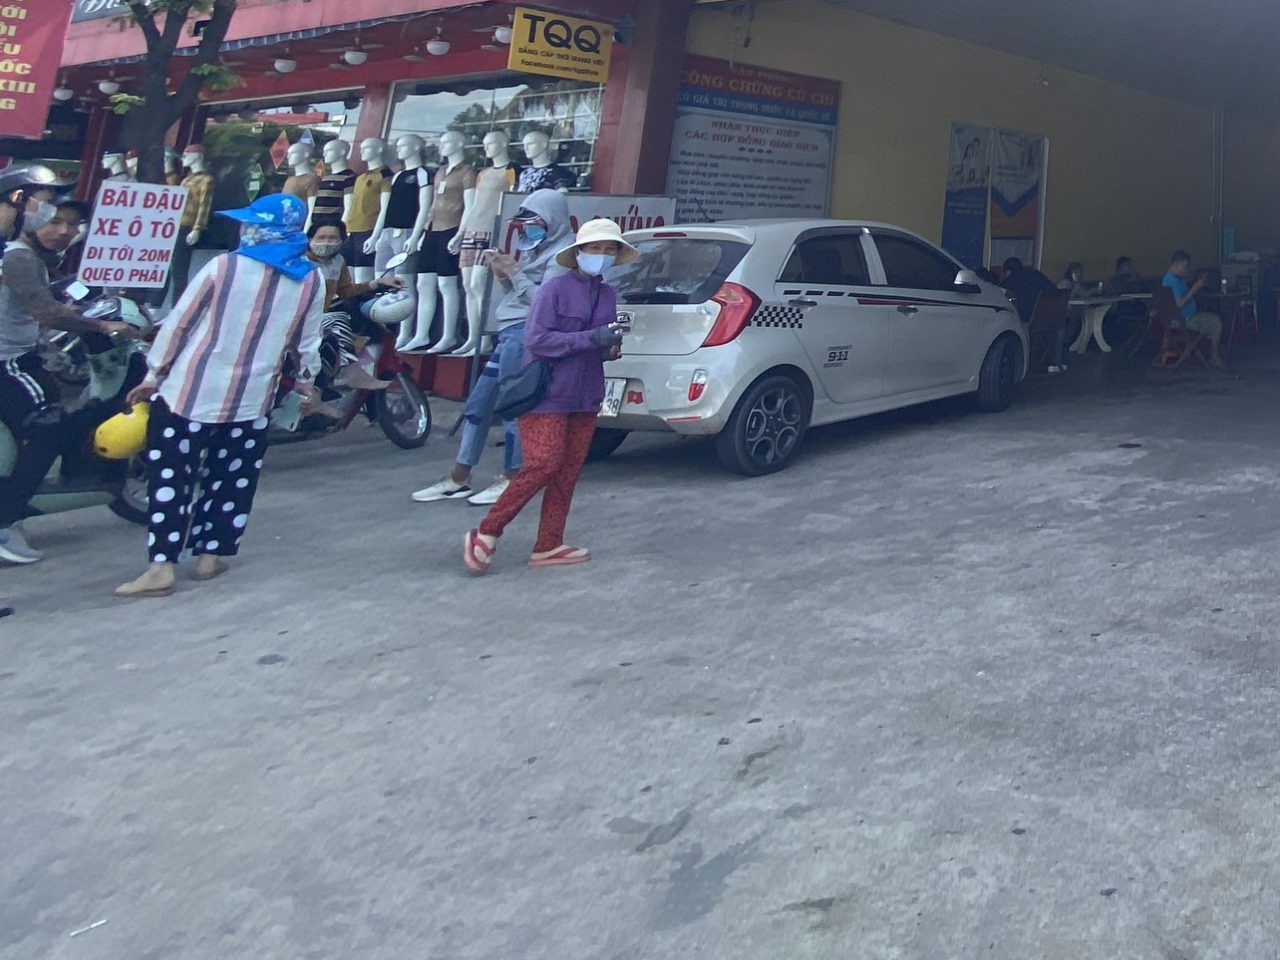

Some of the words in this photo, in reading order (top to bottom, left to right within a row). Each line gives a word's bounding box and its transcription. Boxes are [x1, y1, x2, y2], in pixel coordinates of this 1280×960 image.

[523, 13, 600, 54] TQQ
[101, 186, 137, 208] BÃI
[143, 188, 184, 213] ĐẬU
[94, 218, 122, 236] XE
[128, 215, 142, 237] Ô
[151, 217, 175, 239] TÔ
[87, 246, 103, 260] ĐI
[109, 244, 133, 261] TỚI
[138, 248, 171, 262] 20M
[82, 267, 124, 284] QUẸO
[128, 264, 165, 282] PHẢI
